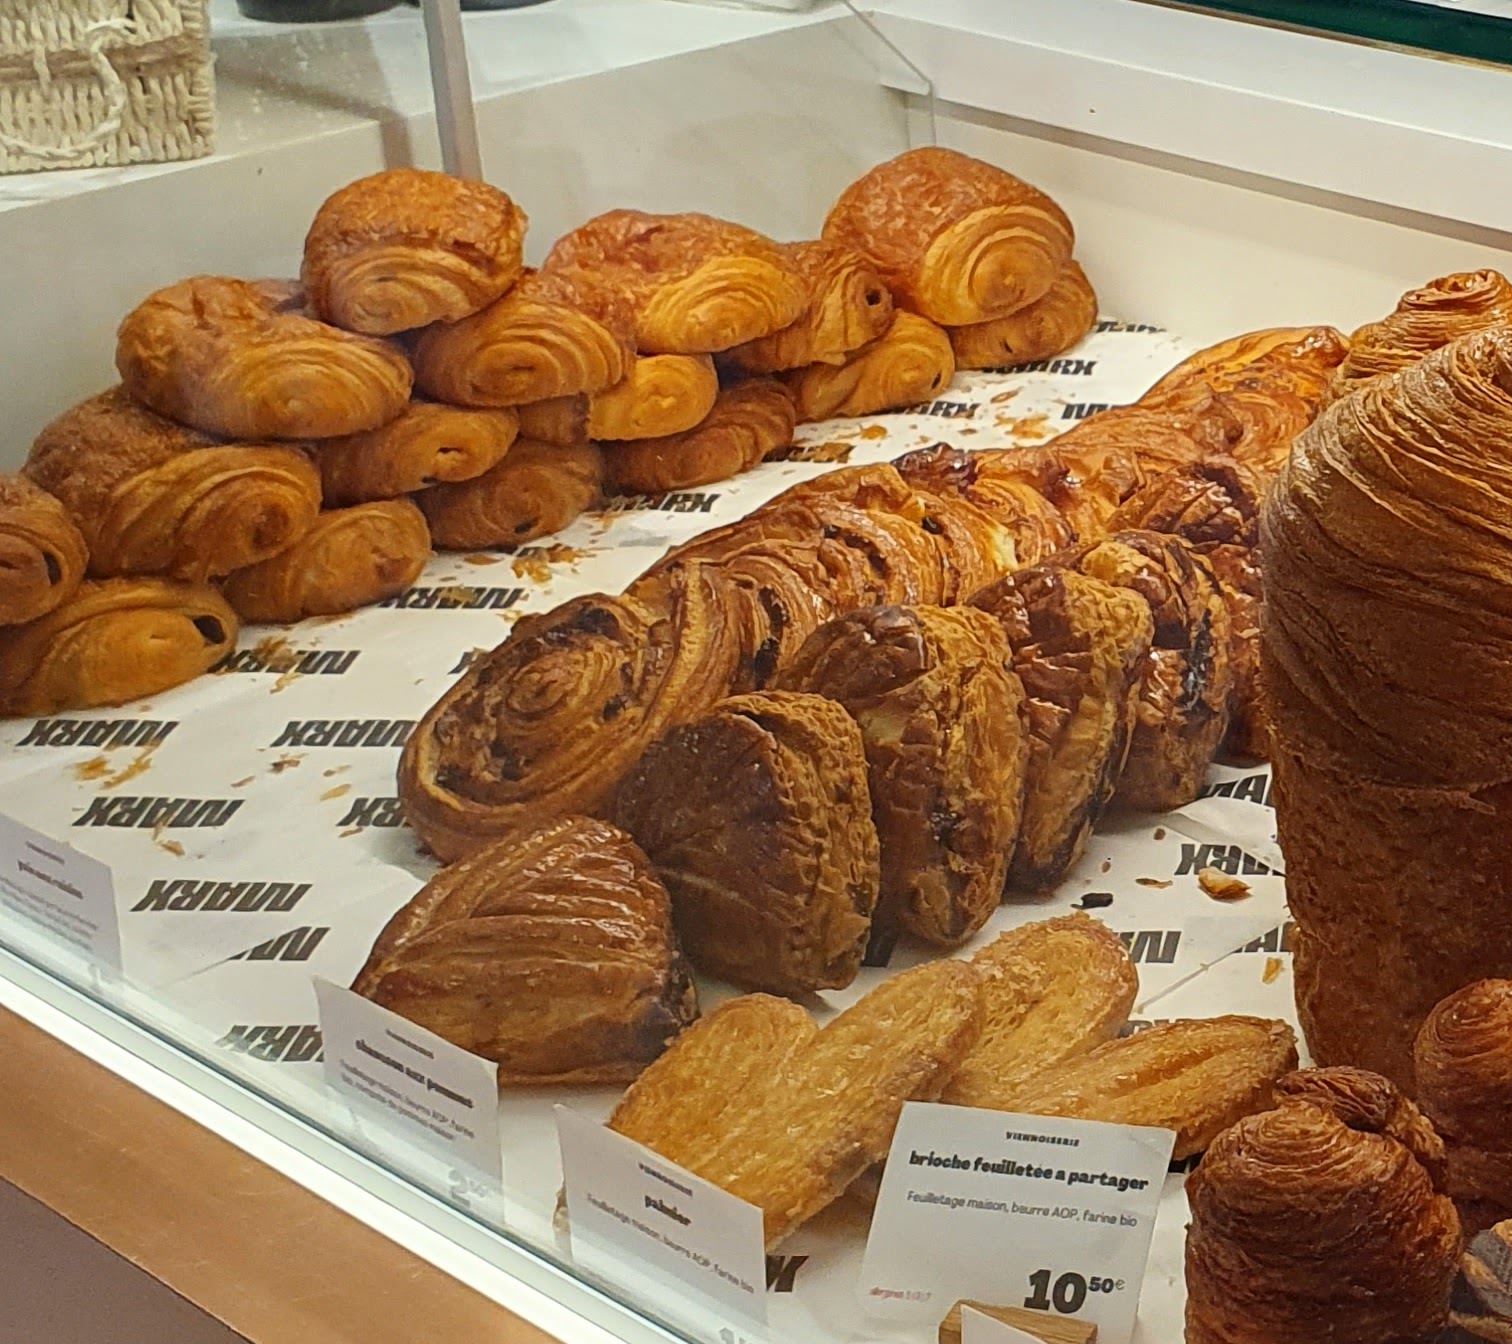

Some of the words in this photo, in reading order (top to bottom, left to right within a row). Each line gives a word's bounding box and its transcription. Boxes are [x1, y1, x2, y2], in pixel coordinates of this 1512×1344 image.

[909, 1150, 972, 1172] brioche
[1067, 1171, 1150, 1193] partager
[907, 1190, 966, 1208] Feuilletage
[1011, 1202, 1051, 1217] beurre
[1083, 1209, 1118, 1225] farine
[1119, 1213, 1139, 1228] bio
